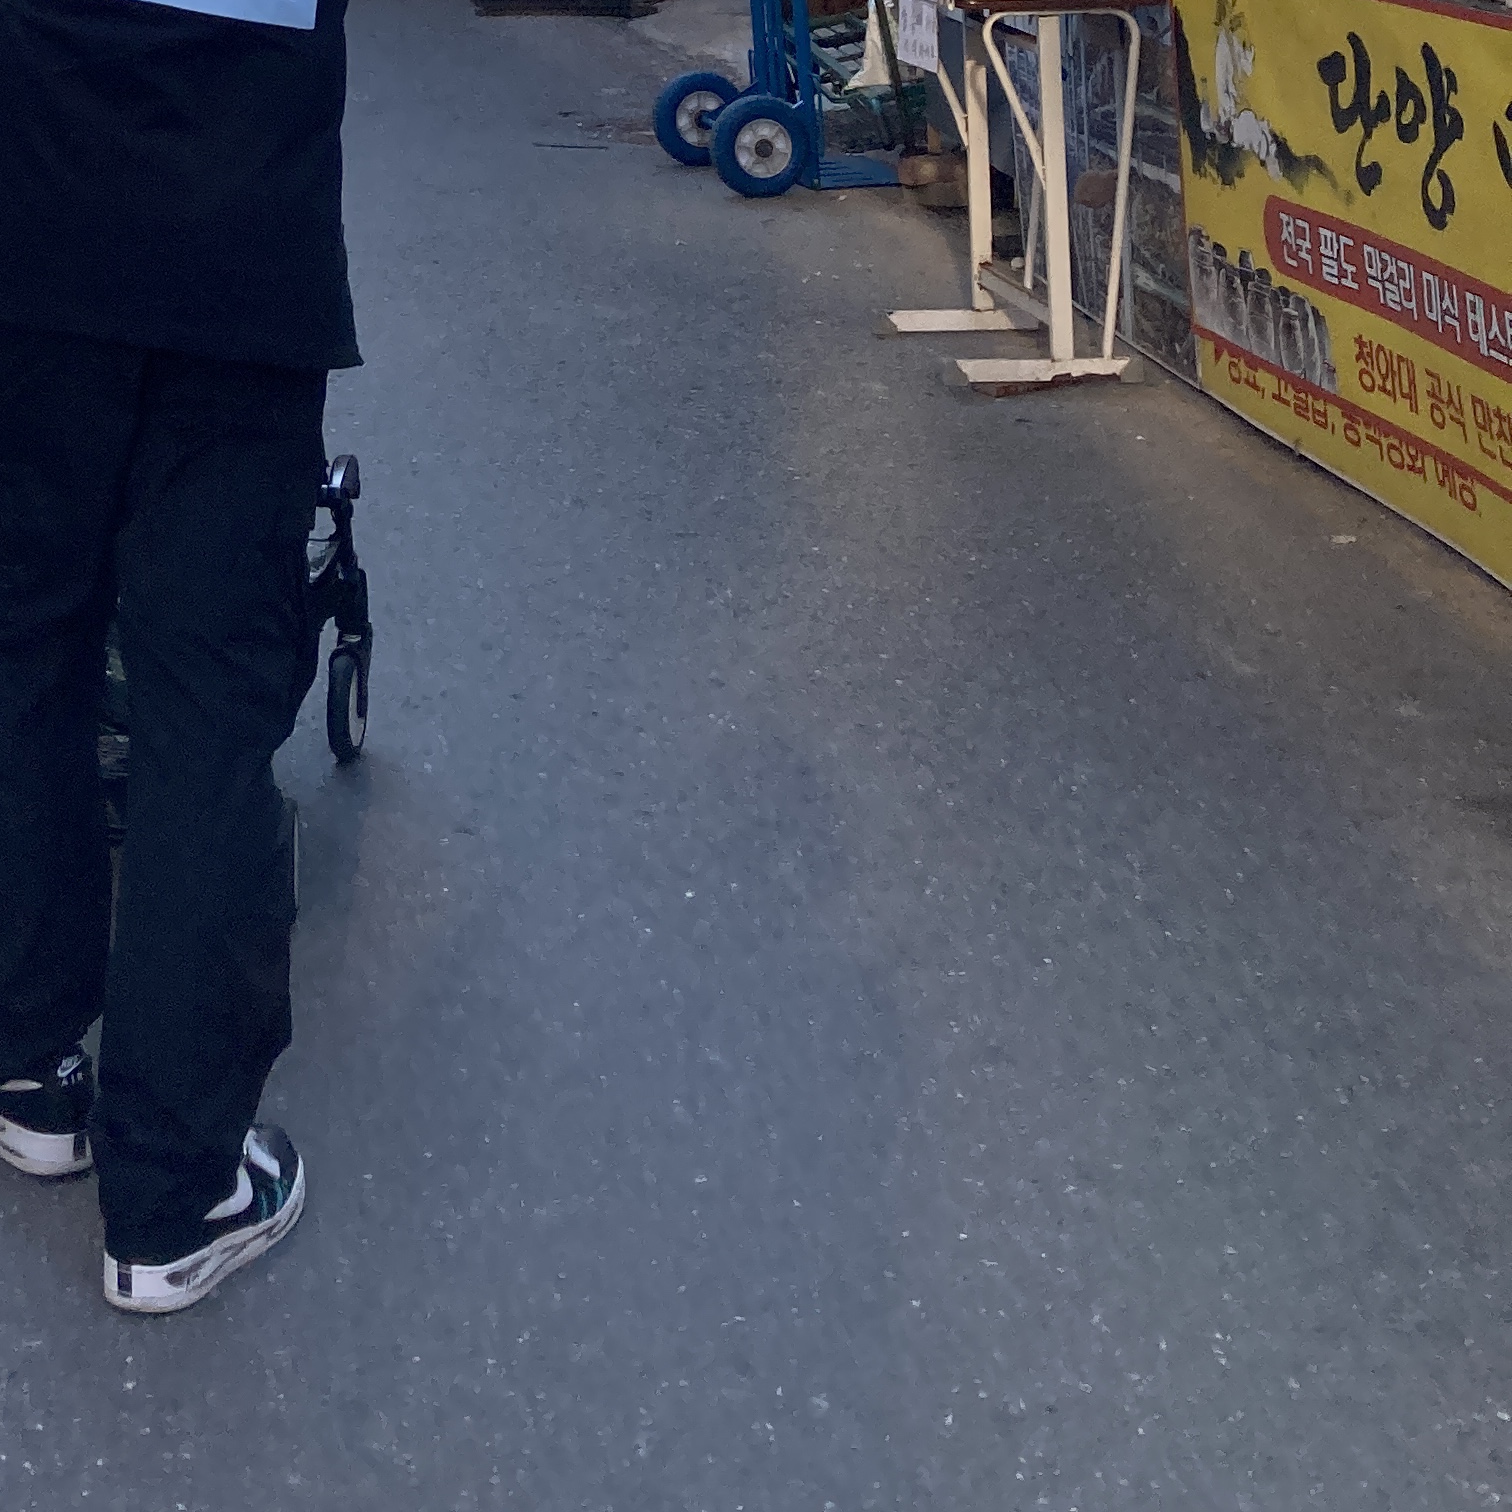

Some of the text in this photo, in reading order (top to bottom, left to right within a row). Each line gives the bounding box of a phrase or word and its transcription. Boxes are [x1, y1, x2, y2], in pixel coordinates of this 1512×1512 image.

[1317, 31, 1465, 231] 단양
[1279, 212, 1314, 275] 전국
[1318, 226, 1359, 290] 팔도
[1364, 243, 1418, 321] 막걸리
[1422, 271, 1462, 344] 미식
[1354, 333, 1419, 415] 청와대
[1425, 367, 1468, 444] 공식
